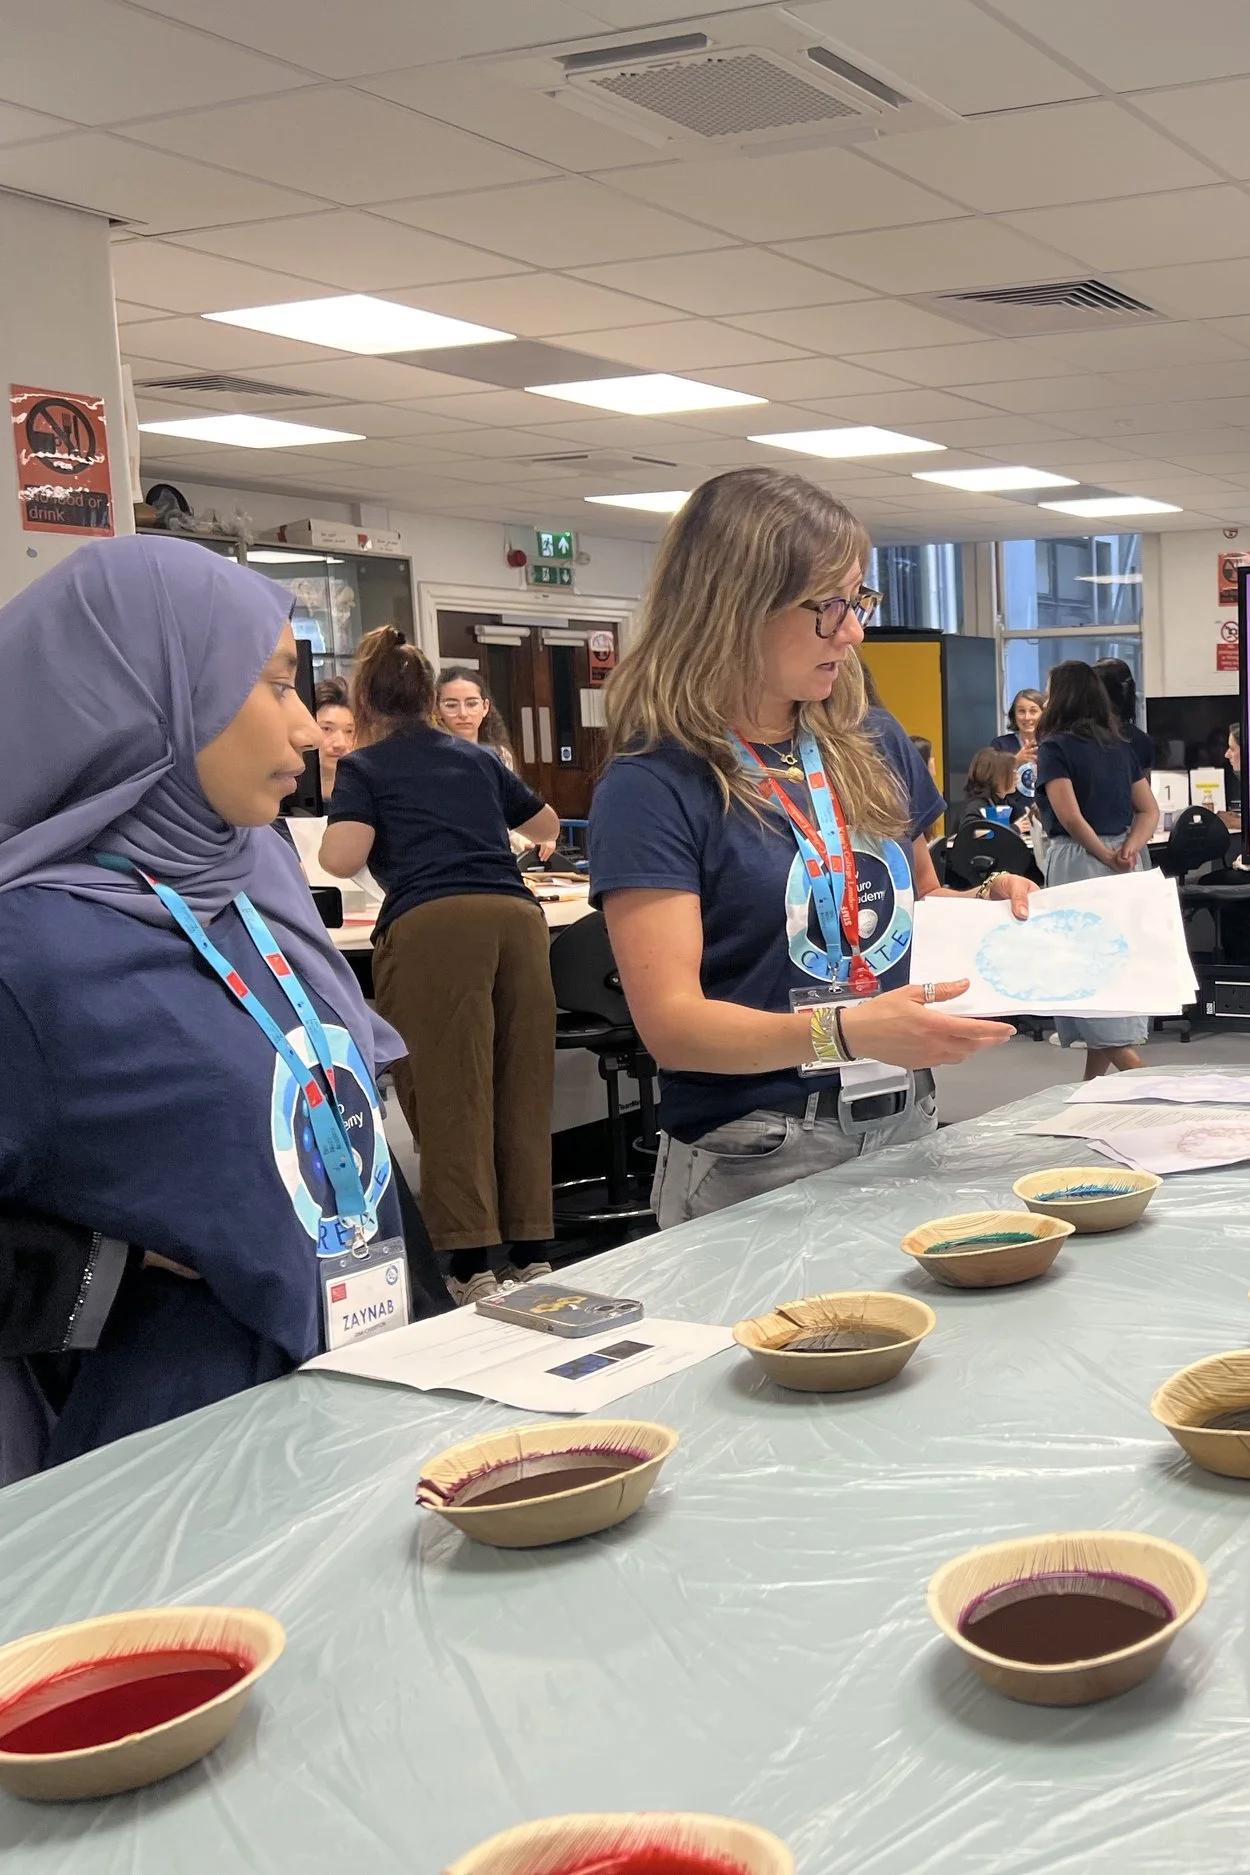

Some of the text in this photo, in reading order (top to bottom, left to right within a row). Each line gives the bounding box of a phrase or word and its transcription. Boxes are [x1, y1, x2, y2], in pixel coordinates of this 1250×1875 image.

[88, 497, 102, 509] or
[29, 506, 65, 522] drink
[841, 905, 852, 927] STAFF
[342, 1299, 394, 1332] ZAYNAB
